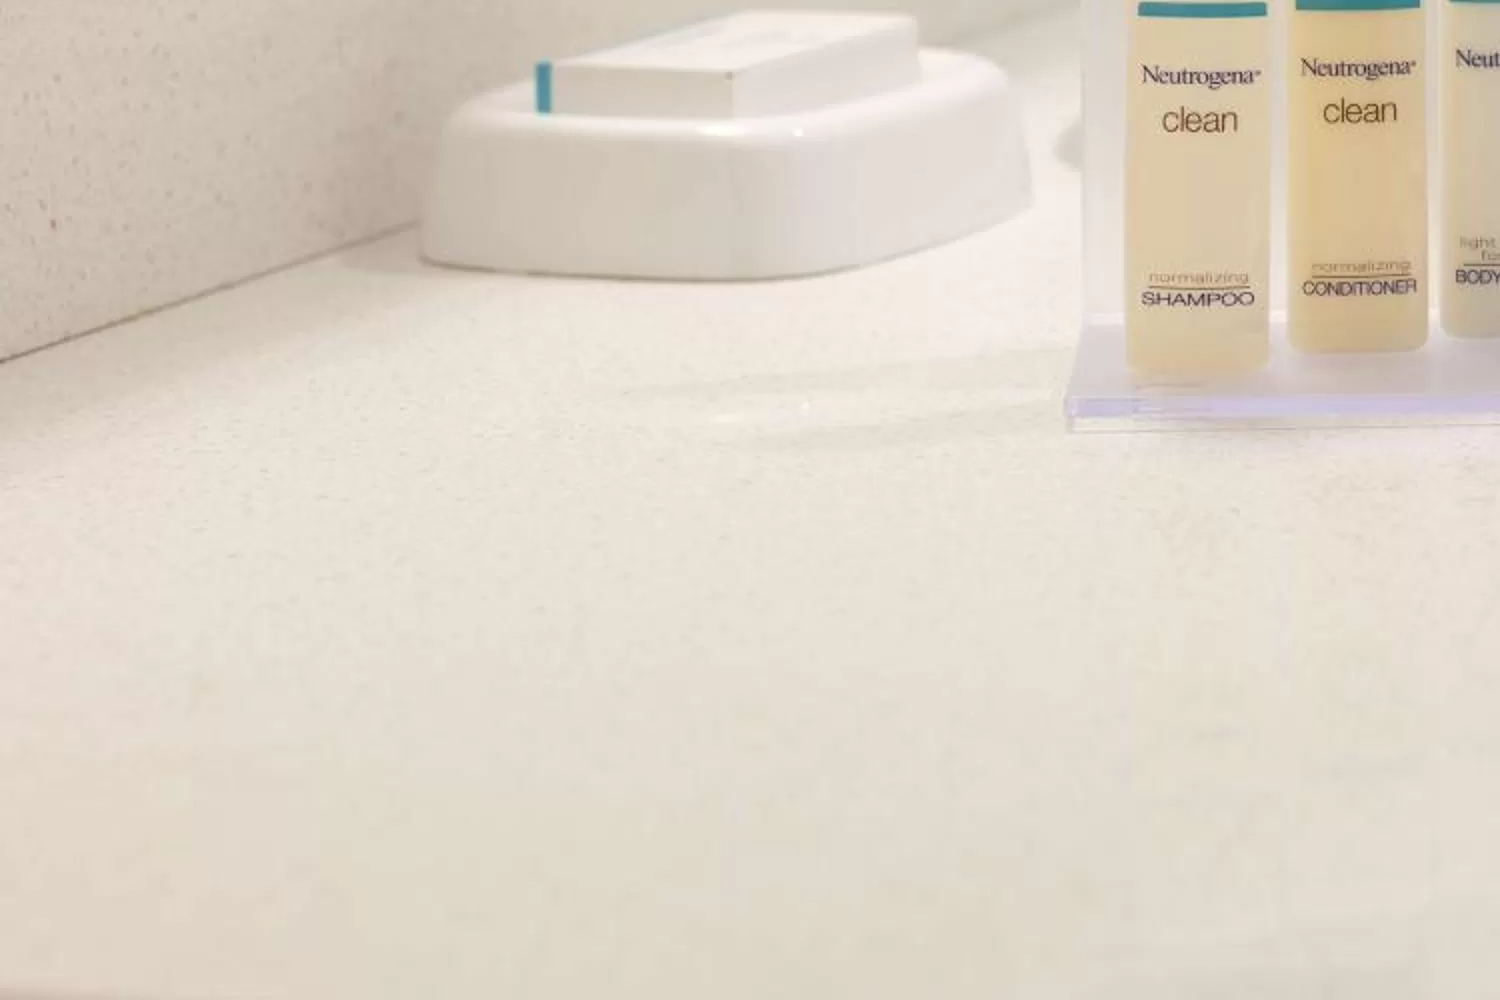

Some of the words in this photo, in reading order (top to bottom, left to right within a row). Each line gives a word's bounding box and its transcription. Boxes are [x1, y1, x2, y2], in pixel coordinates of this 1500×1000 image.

[1323, 98, 1397, 124] clean
[1162, 107, 1238, 133] clean
[1460, 235, 1496, 250] light
[1312, 259, 1412, 275] normalizing
[1149, 271, 1249, 286] normalizing
[1302, 280, 1417, 296] CONDITIONER
[1141, 292, 1254, 307] SHAMPOO
